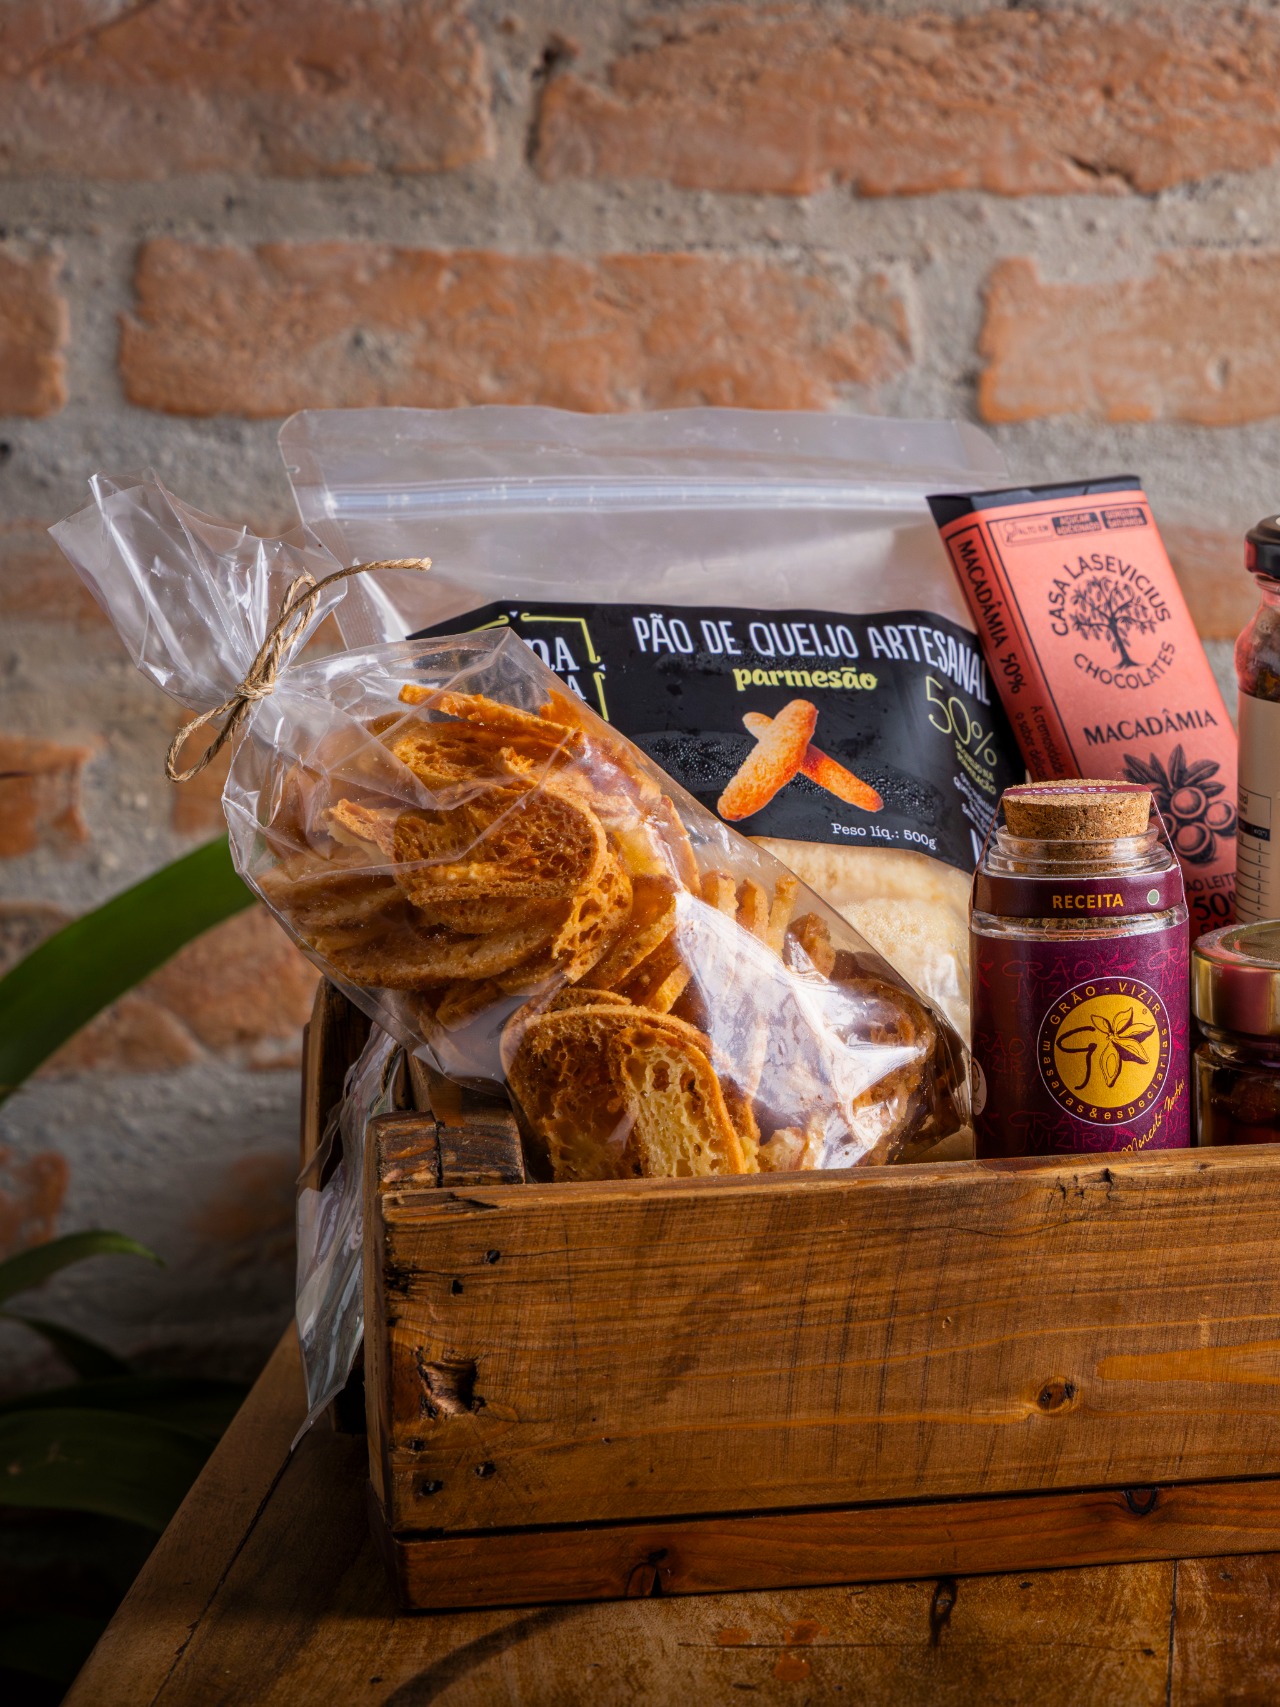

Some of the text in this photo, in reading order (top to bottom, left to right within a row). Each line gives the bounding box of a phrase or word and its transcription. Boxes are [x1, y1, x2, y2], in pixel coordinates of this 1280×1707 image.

[957, 539, 1028, 695] MACADÂMIA 50%
[1048, 553, 1172, 637] CASA LASEVICIUS
[632, 613, 992, 705] PÃO DE QUEIJO ARTESANAL
[732, 666, 878, 691] parmesão
[1073, 641, 1176, 690] CHOCOLATES
[925, 675, 998, 767] 50%
[1082, 708, 1218, 746] MACADÂMIA
[831, 822, 867, 837] Peso
[903, 828, 938, 851] 500g
[1052, 893, 1124, 909] RECEITA
[1050, 985, 1096, 1026] GRÃO
[1119, 982, 1161, 1015] VIZIR
